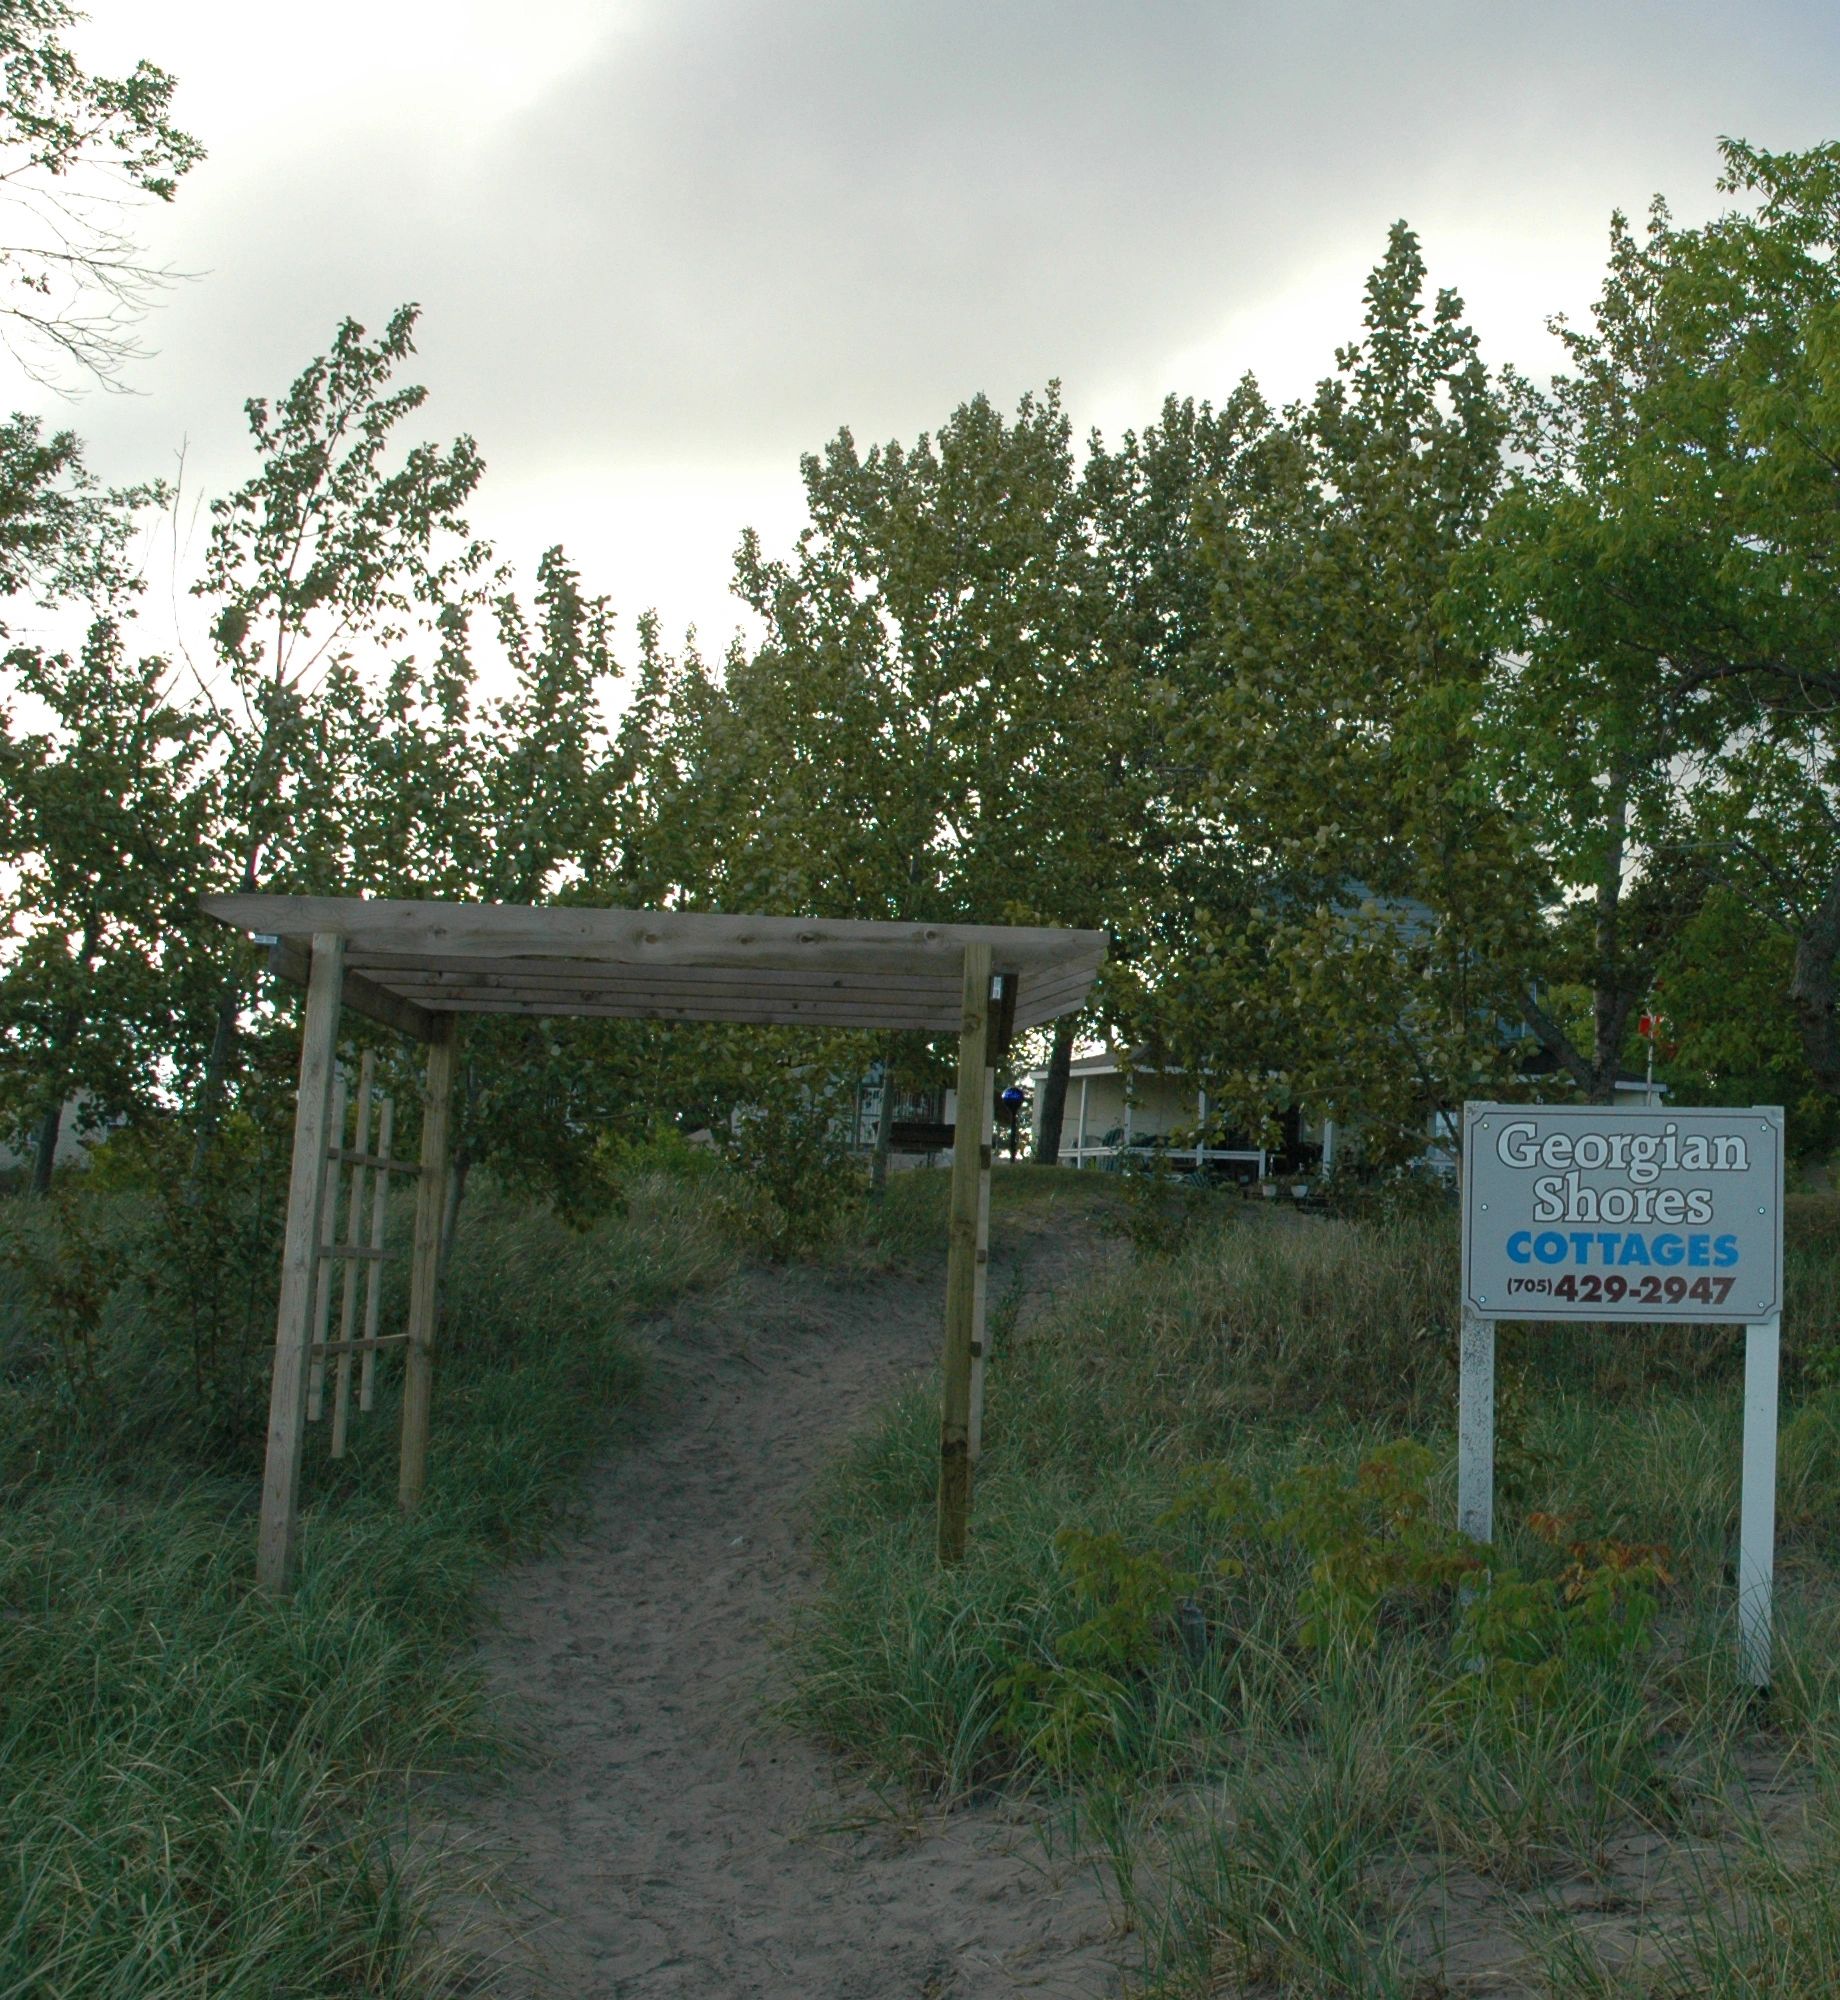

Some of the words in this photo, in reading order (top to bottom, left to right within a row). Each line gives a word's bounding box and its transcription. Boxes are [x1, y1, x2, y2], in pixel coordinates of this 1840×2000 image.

[1496, 1121, 1750, 1184] Georgian
[1533, 1169, 1713, 1225] Shores
[1506, 1231, 1739, 1267] COTTAGES
[1507, 1278, 1553, 1296] (705)
[1554, 1274, 1736, 1305] 429-2947
